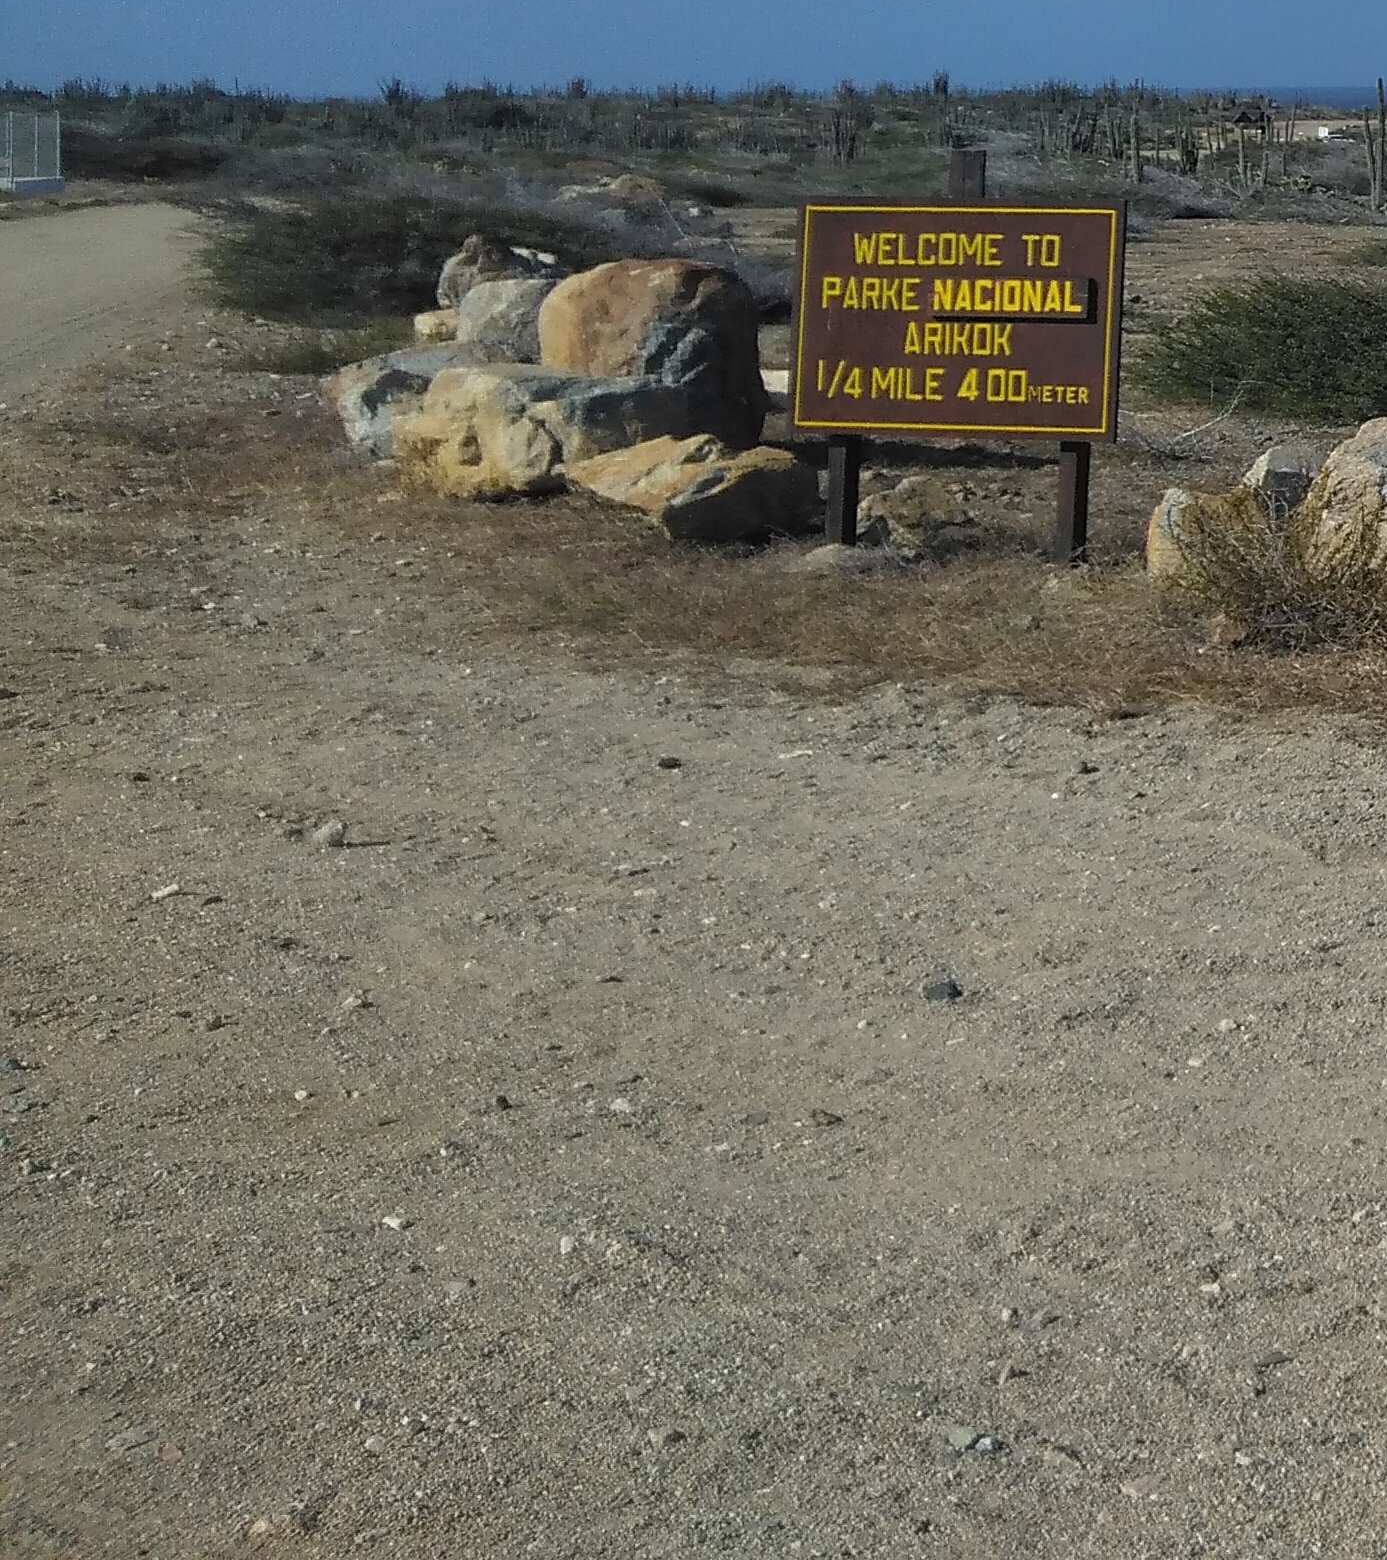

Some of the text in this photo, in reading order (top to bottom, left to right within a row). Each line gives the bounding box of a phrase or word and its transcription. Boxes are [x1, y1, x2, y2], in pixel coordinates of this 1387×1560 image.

[854, 232, 1061, 267] WELCOME TO
[821, 276, 1083, 312] PARKE NACIONAL
[904, 322, 1013, 355] ARIKOK
[817, 360, 862, 398] 1/4
[871, 367, 945, 401] MILE
